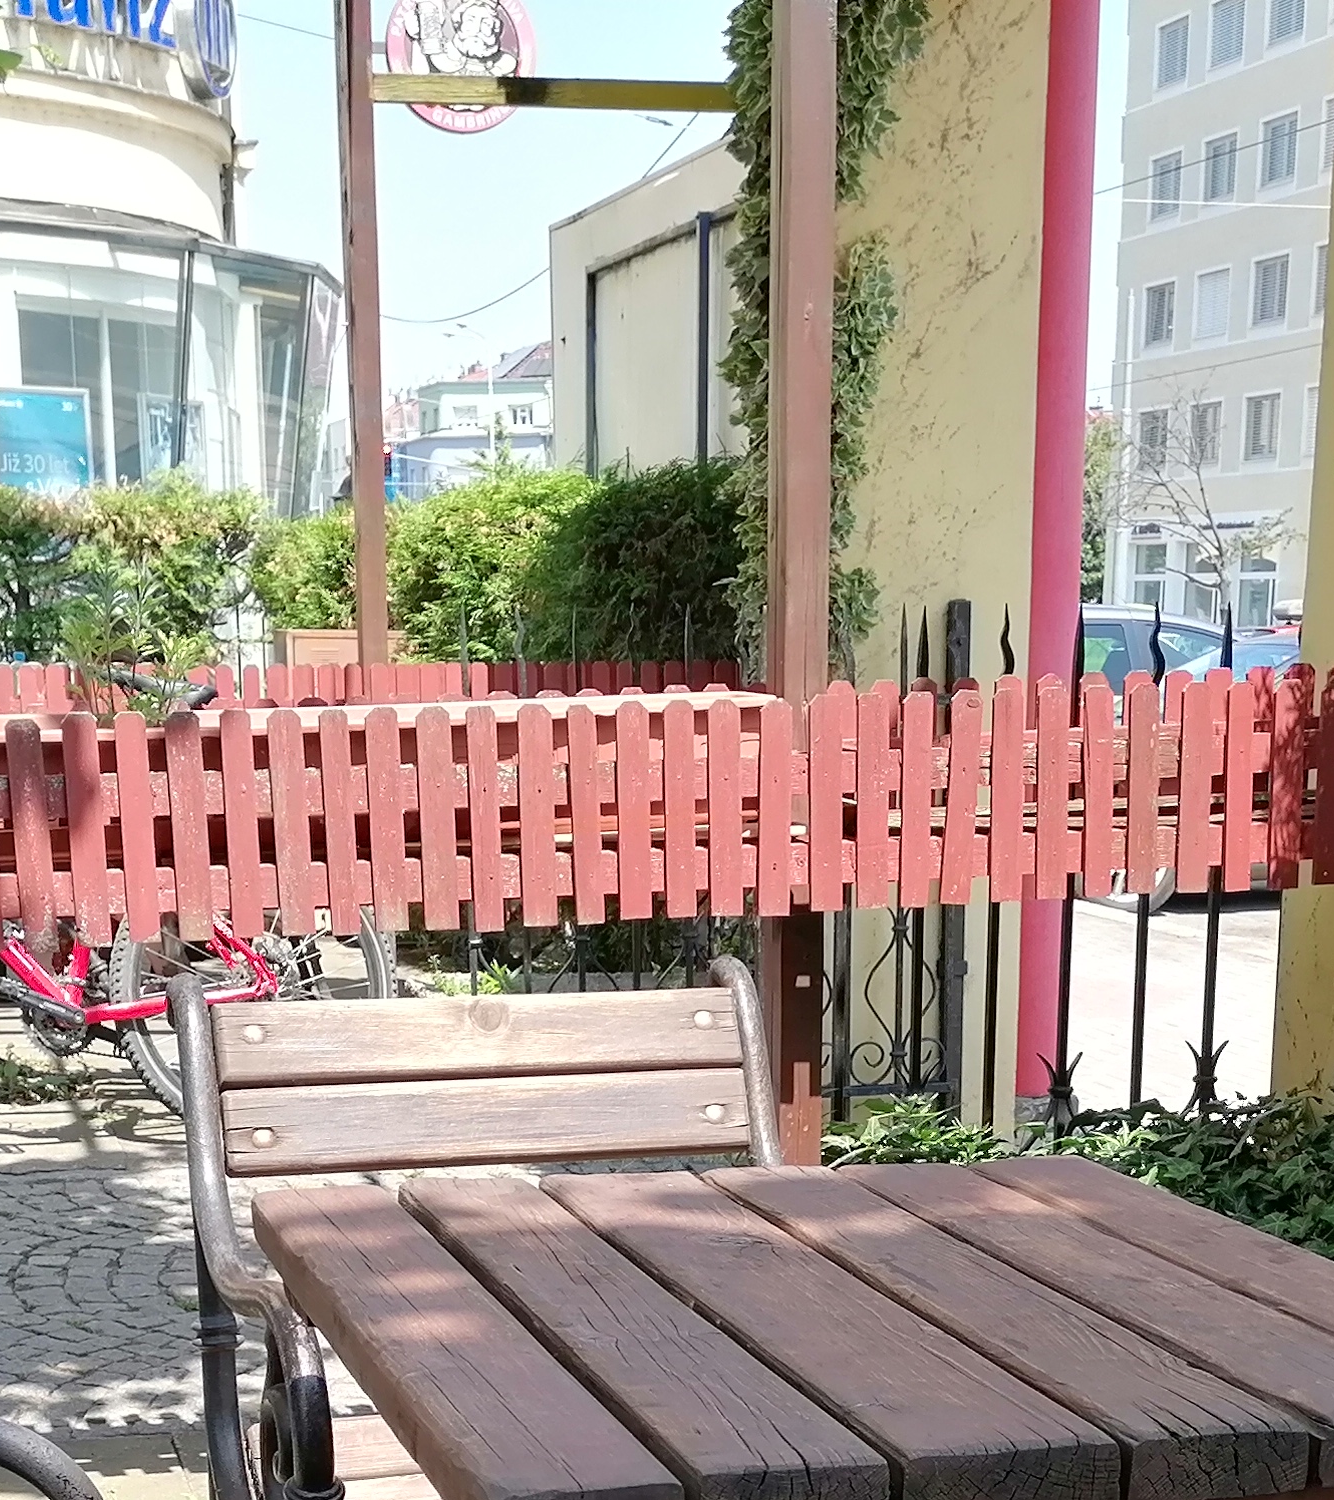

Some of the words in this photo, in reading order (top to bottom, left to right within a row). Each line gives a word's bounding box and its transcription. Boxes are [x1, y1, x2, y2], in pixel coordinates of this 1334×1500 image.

[432, 106, 517, 129] GAMBRIN
[0, 452, 21, 473] Již
[23, 454, 45, 473] 30
